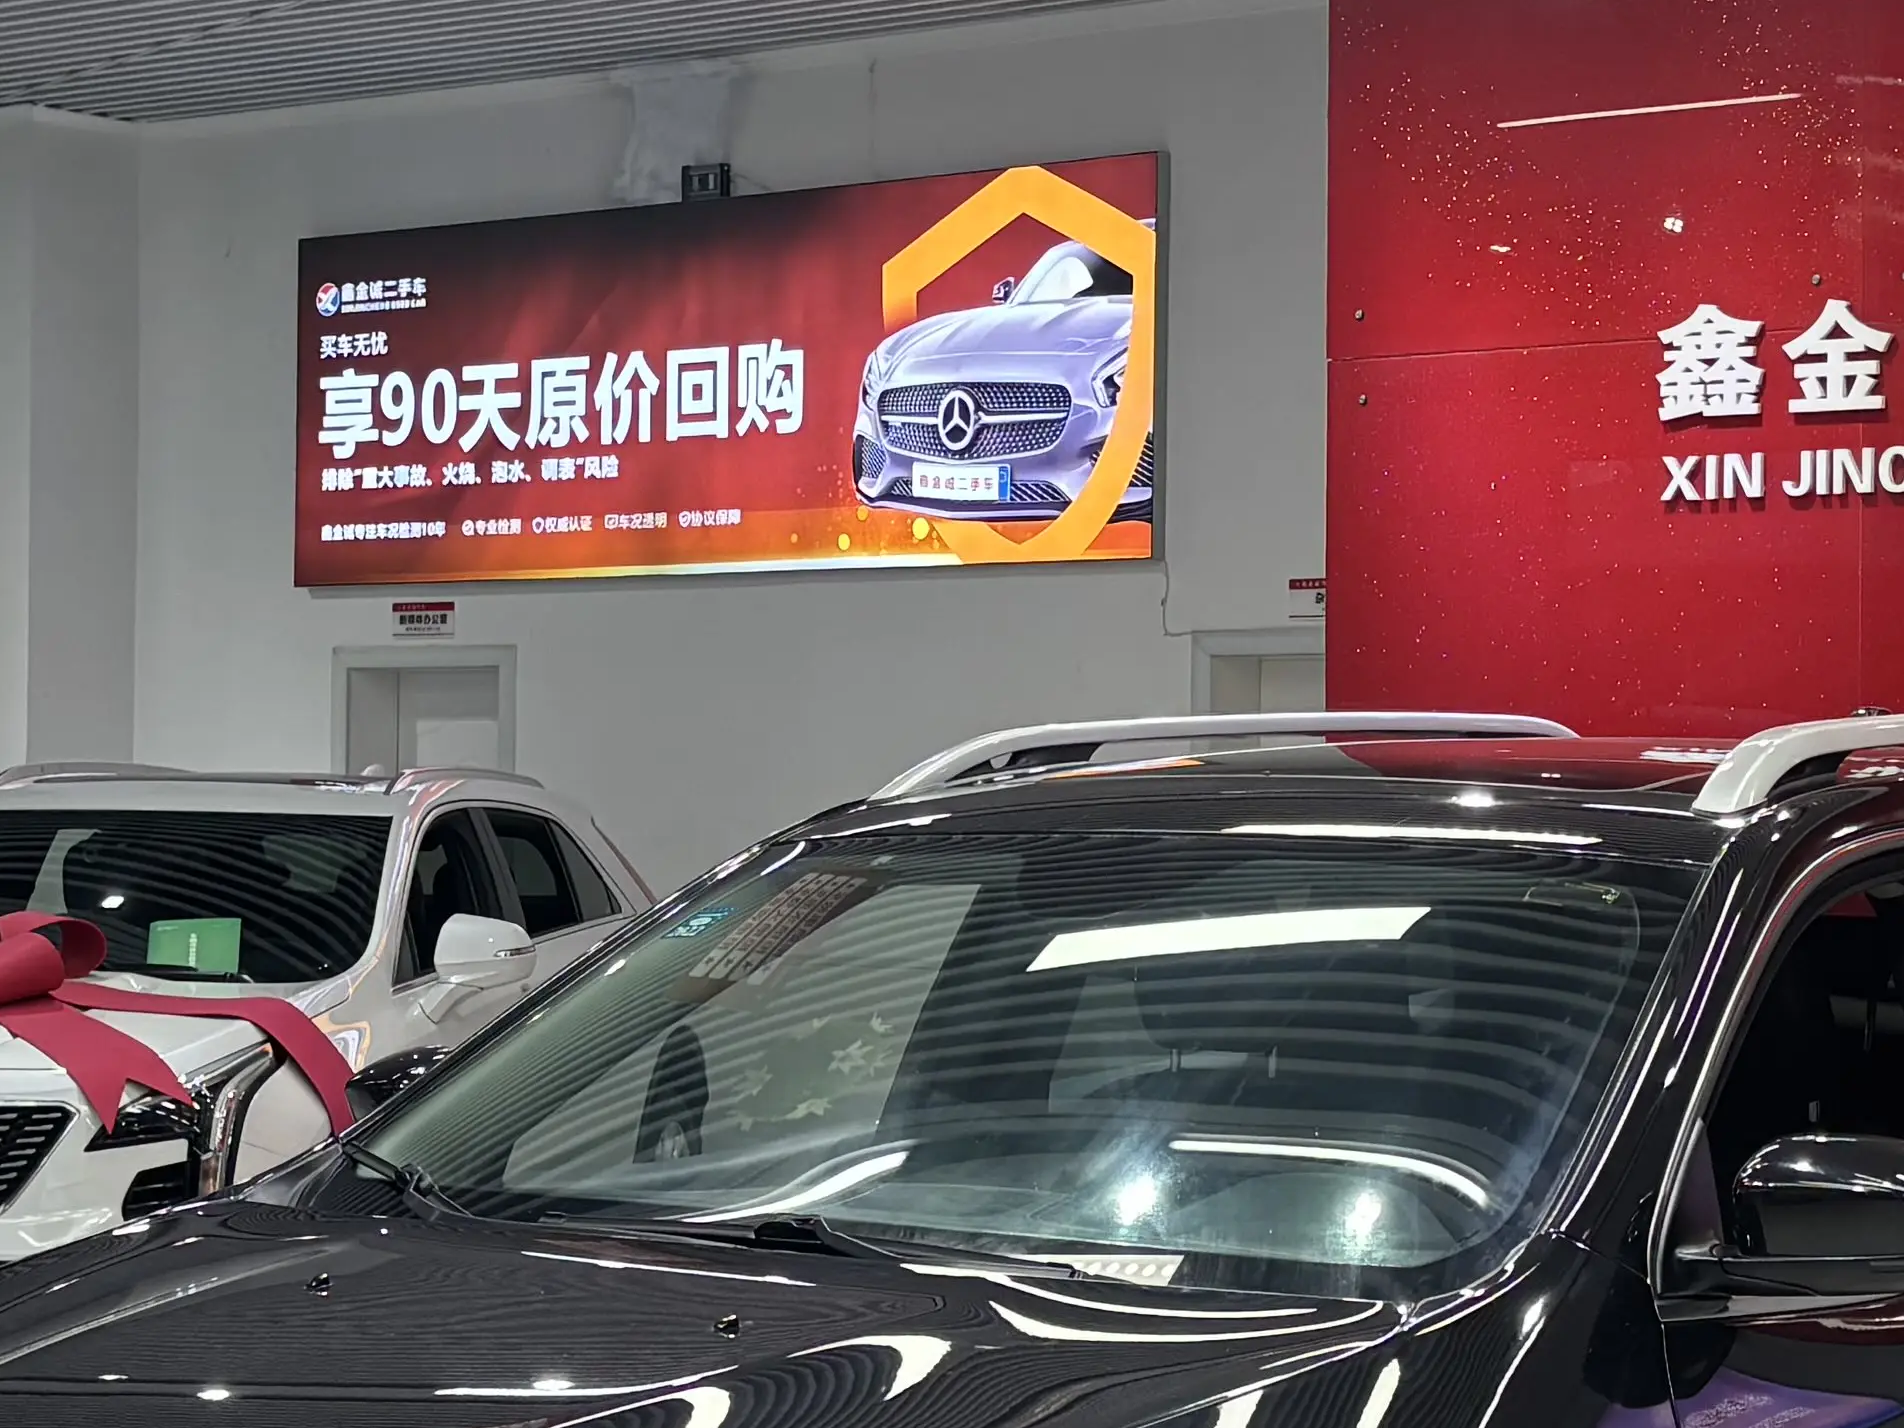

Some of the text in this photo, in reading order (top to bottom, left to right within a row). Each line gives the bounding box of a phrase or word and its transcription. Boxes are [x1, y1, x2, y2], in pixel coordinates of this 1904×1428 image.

[319, 331, 388, 359] 买车无忧
[318, 339, 805, 460] 享90天原价回购
[1659, 451, 1765, 502] XIN
